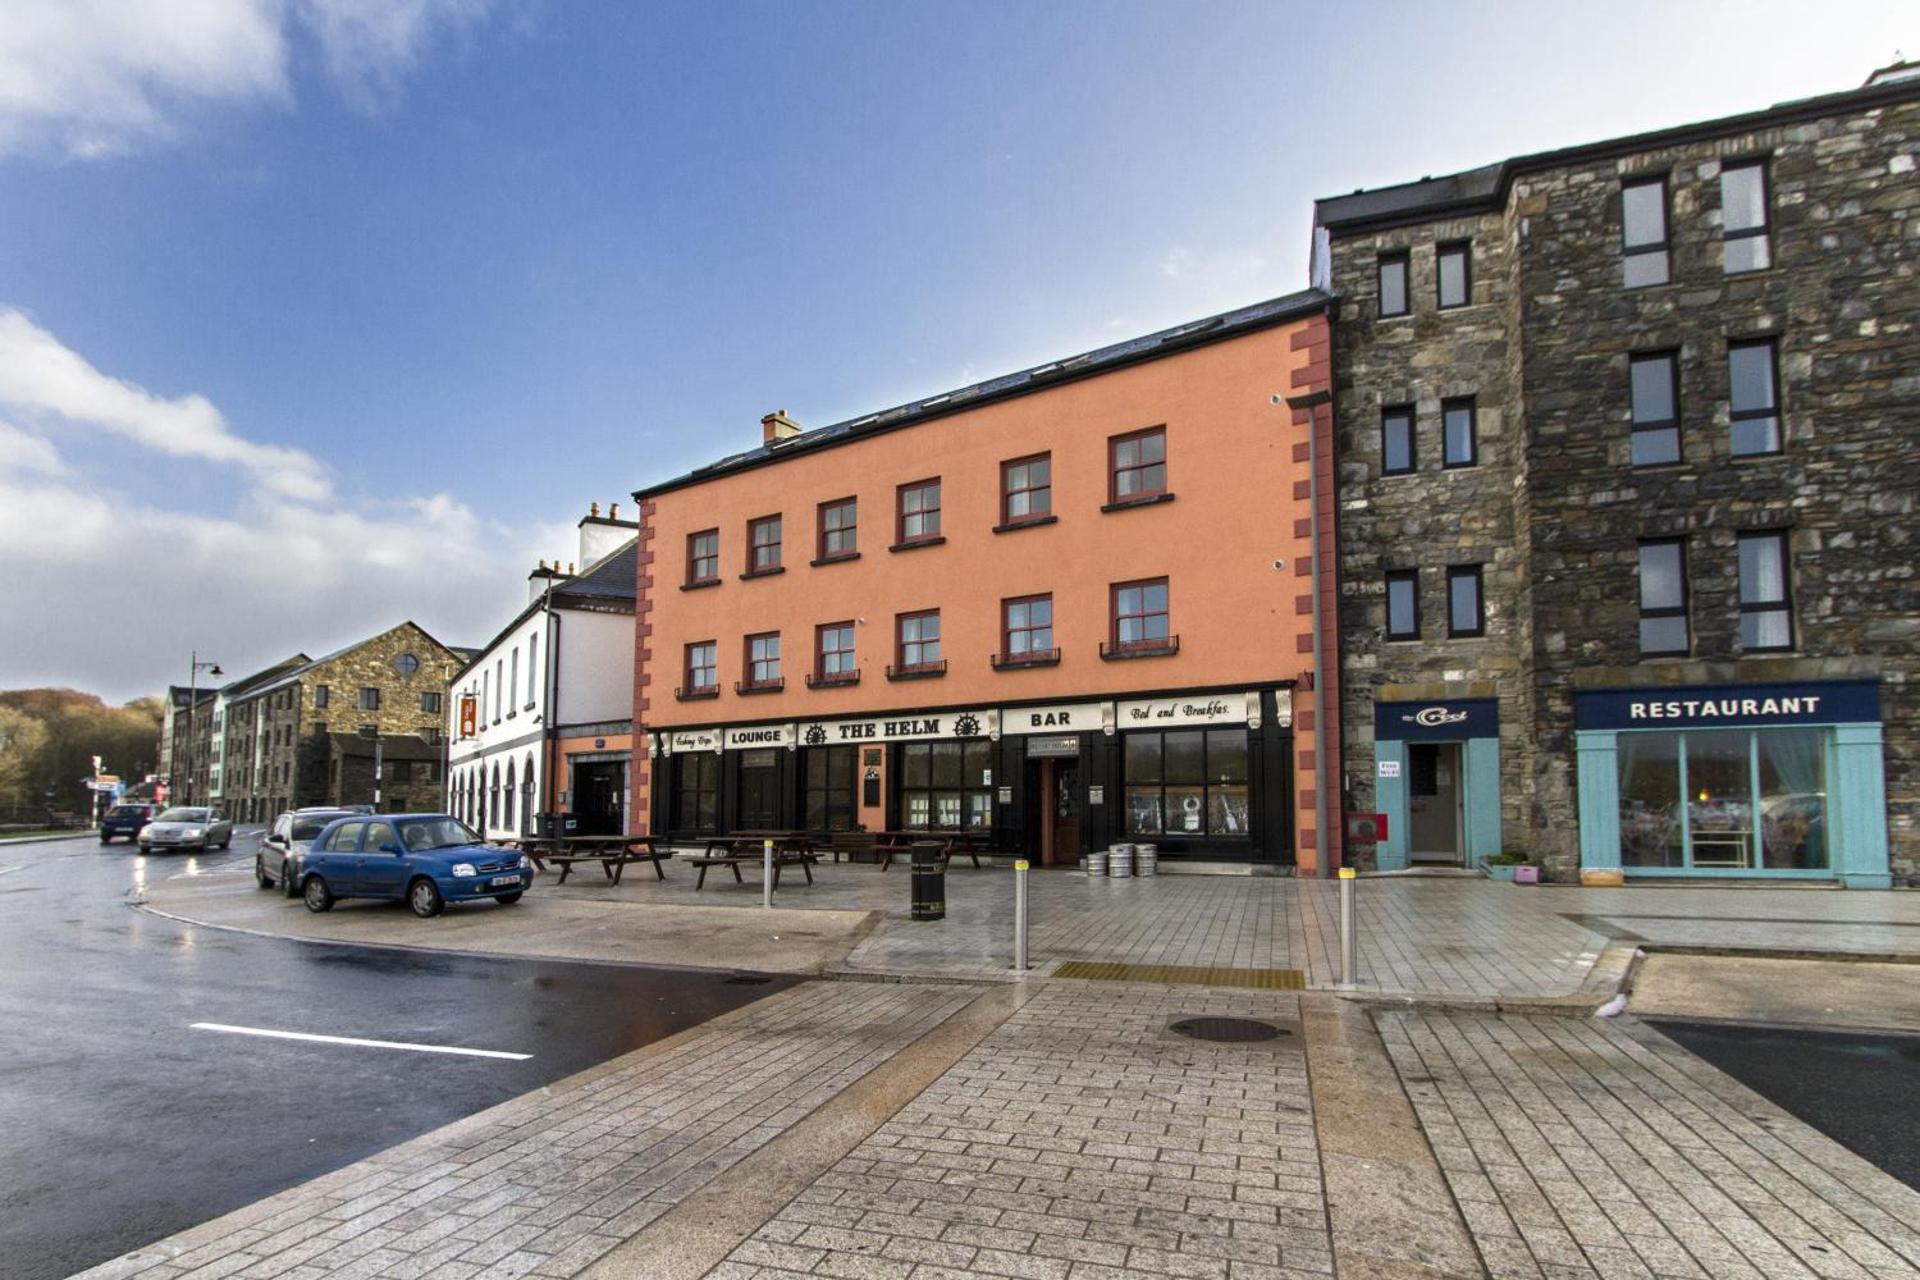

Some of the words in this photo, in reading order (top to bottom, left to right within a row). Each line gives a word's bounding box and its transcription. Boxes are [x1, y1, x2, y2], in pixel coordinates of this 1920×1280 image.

[1130, 705, 1152, 719] Bed
[1157, 703, 1178, 718] and
[1630, 697, 1820, 719] RESTAURANT
[1031, 712, 1071, 727] BAR
[731, 730, 781, 744] LOUNGE
[839, 723, 876, 739] THE
[884, 719, 940, 737] HELM
